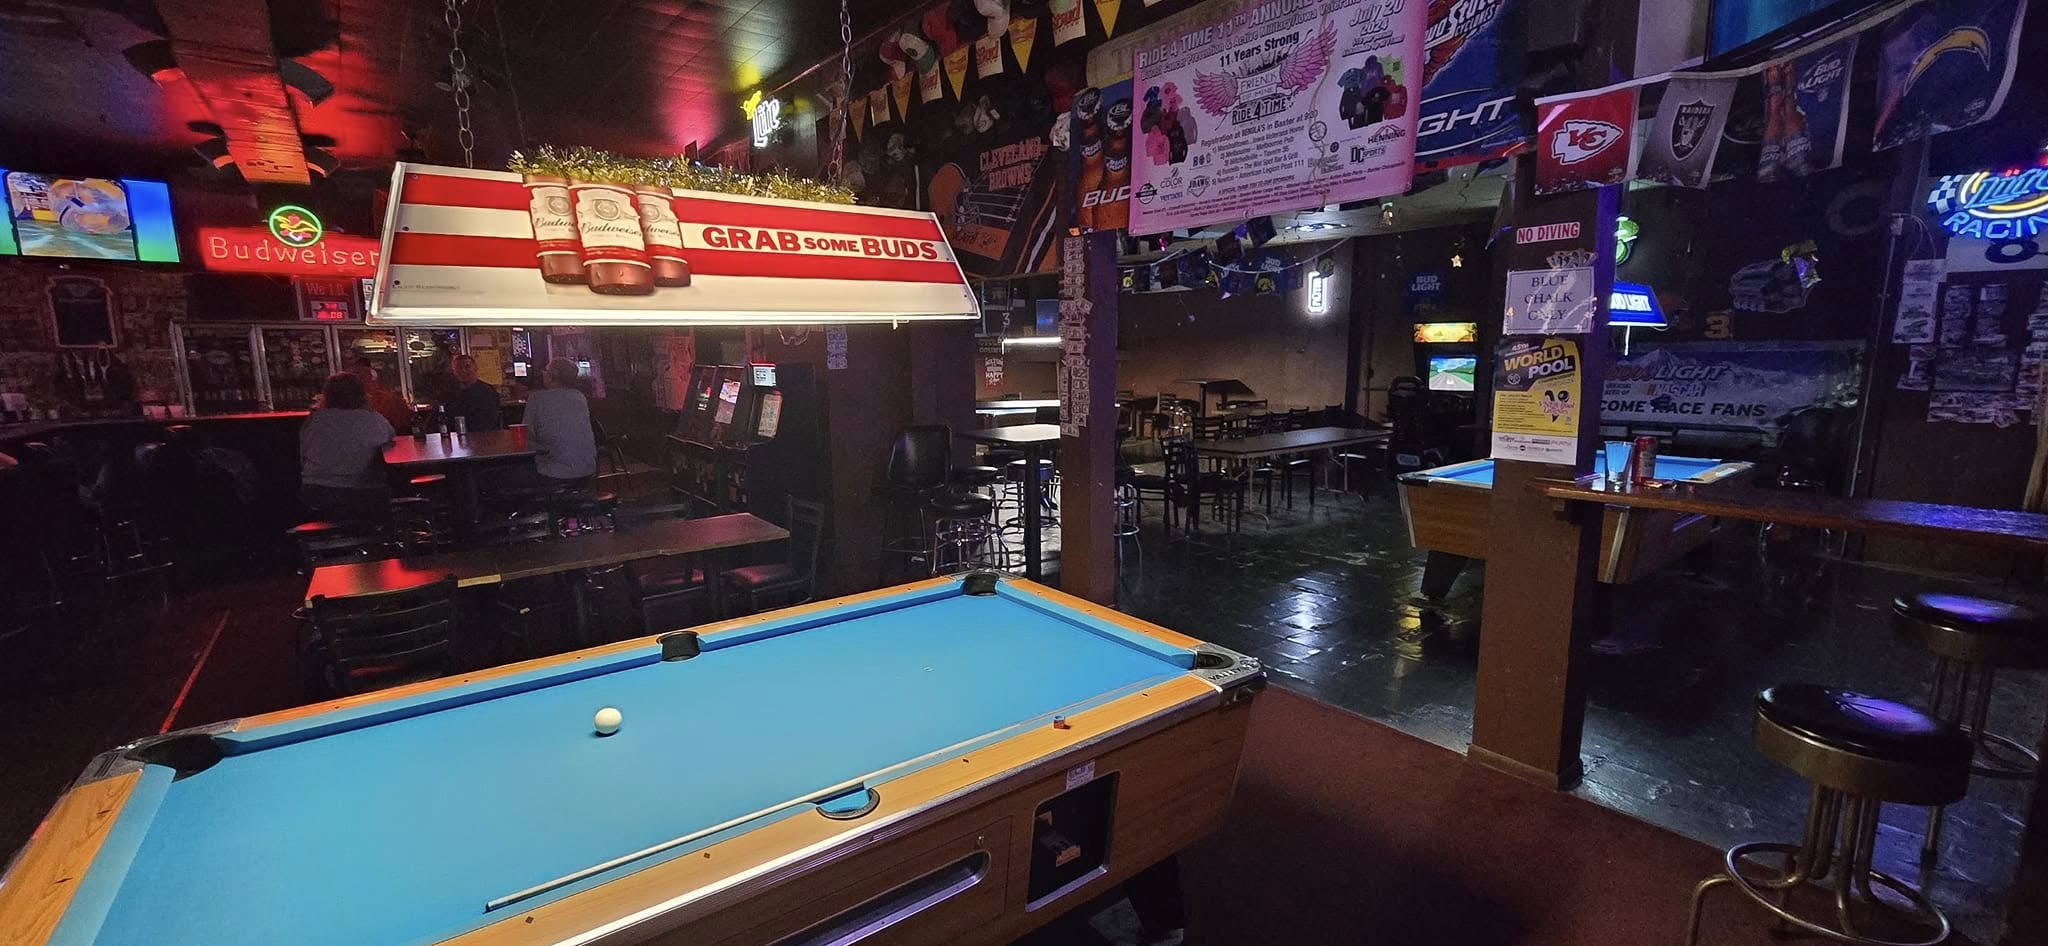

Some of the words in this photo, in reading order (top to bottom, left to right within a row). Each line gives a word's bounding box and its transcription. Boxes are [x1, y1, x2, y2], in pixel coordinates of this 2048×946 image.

[1349, 4, 1382, 27] July
[1383, 0, 1405, 17] 20
[1139, 46, 1168, 69] RIDE
[1170, 43, 1179, 57] 4
[1181, 26, 1213, 53] TIME
[1248, 0, 1313, 28] ANNU
[1360, 17, 1388, 36] 2024
[1234, 31, 1259, 47] Active
[1220, 55, 1231, 68] 11
[1234, 44, 1261, 63] Years
[1264, 31, 1300, 52] Strong
[1805, 67, 1845, 88] LIGHT
[1814, 59, 1841, 77] BUD
[1232, 109, 1251, 123] RIDE
[1253, 103, 1261, 121] 4
[1263, 98, 1286, 114] TIME
[1417, 95, 1516, 137] GHT
[752, 99, 780, 147] Lite
[1201, 133, 1233, 147] Registration
[1274, 117, 1295, 129] Baxter
[1289, 125, 1305, 134] Home
[1368, 129, 1406, 144] HENNING
[581, 222, 642, 237] Budweiser
[1518, 229, 1533, 242] NO
[1537, 223, 1579, 240] DIVING
[1944, 212, 2048, 238] RACIN
[209, 237, 380, 266] Budweiser
[702, 226, 802, 252] GRAB
[804, 237, 860, 253] SOME
[861, 237, 938, 260] BUDS
[1411, 282, 1441, 291] LIGHT
[1415, 275, 1438, 283] BUD
[1531, 275, 1569, 288] BLUE
[1524, 292, 1574, 304] CHALK
[1504, 346, 1563, 371] WORLD
[1528, 358, 1573, 379] POOL
[1654, 365, 1730, 380] LIGHT
[1600, 400, 1647, 413] COME
[1711, 403, 1767, 417] FANS
[1208, 667, 1242, 681] VALLEY
